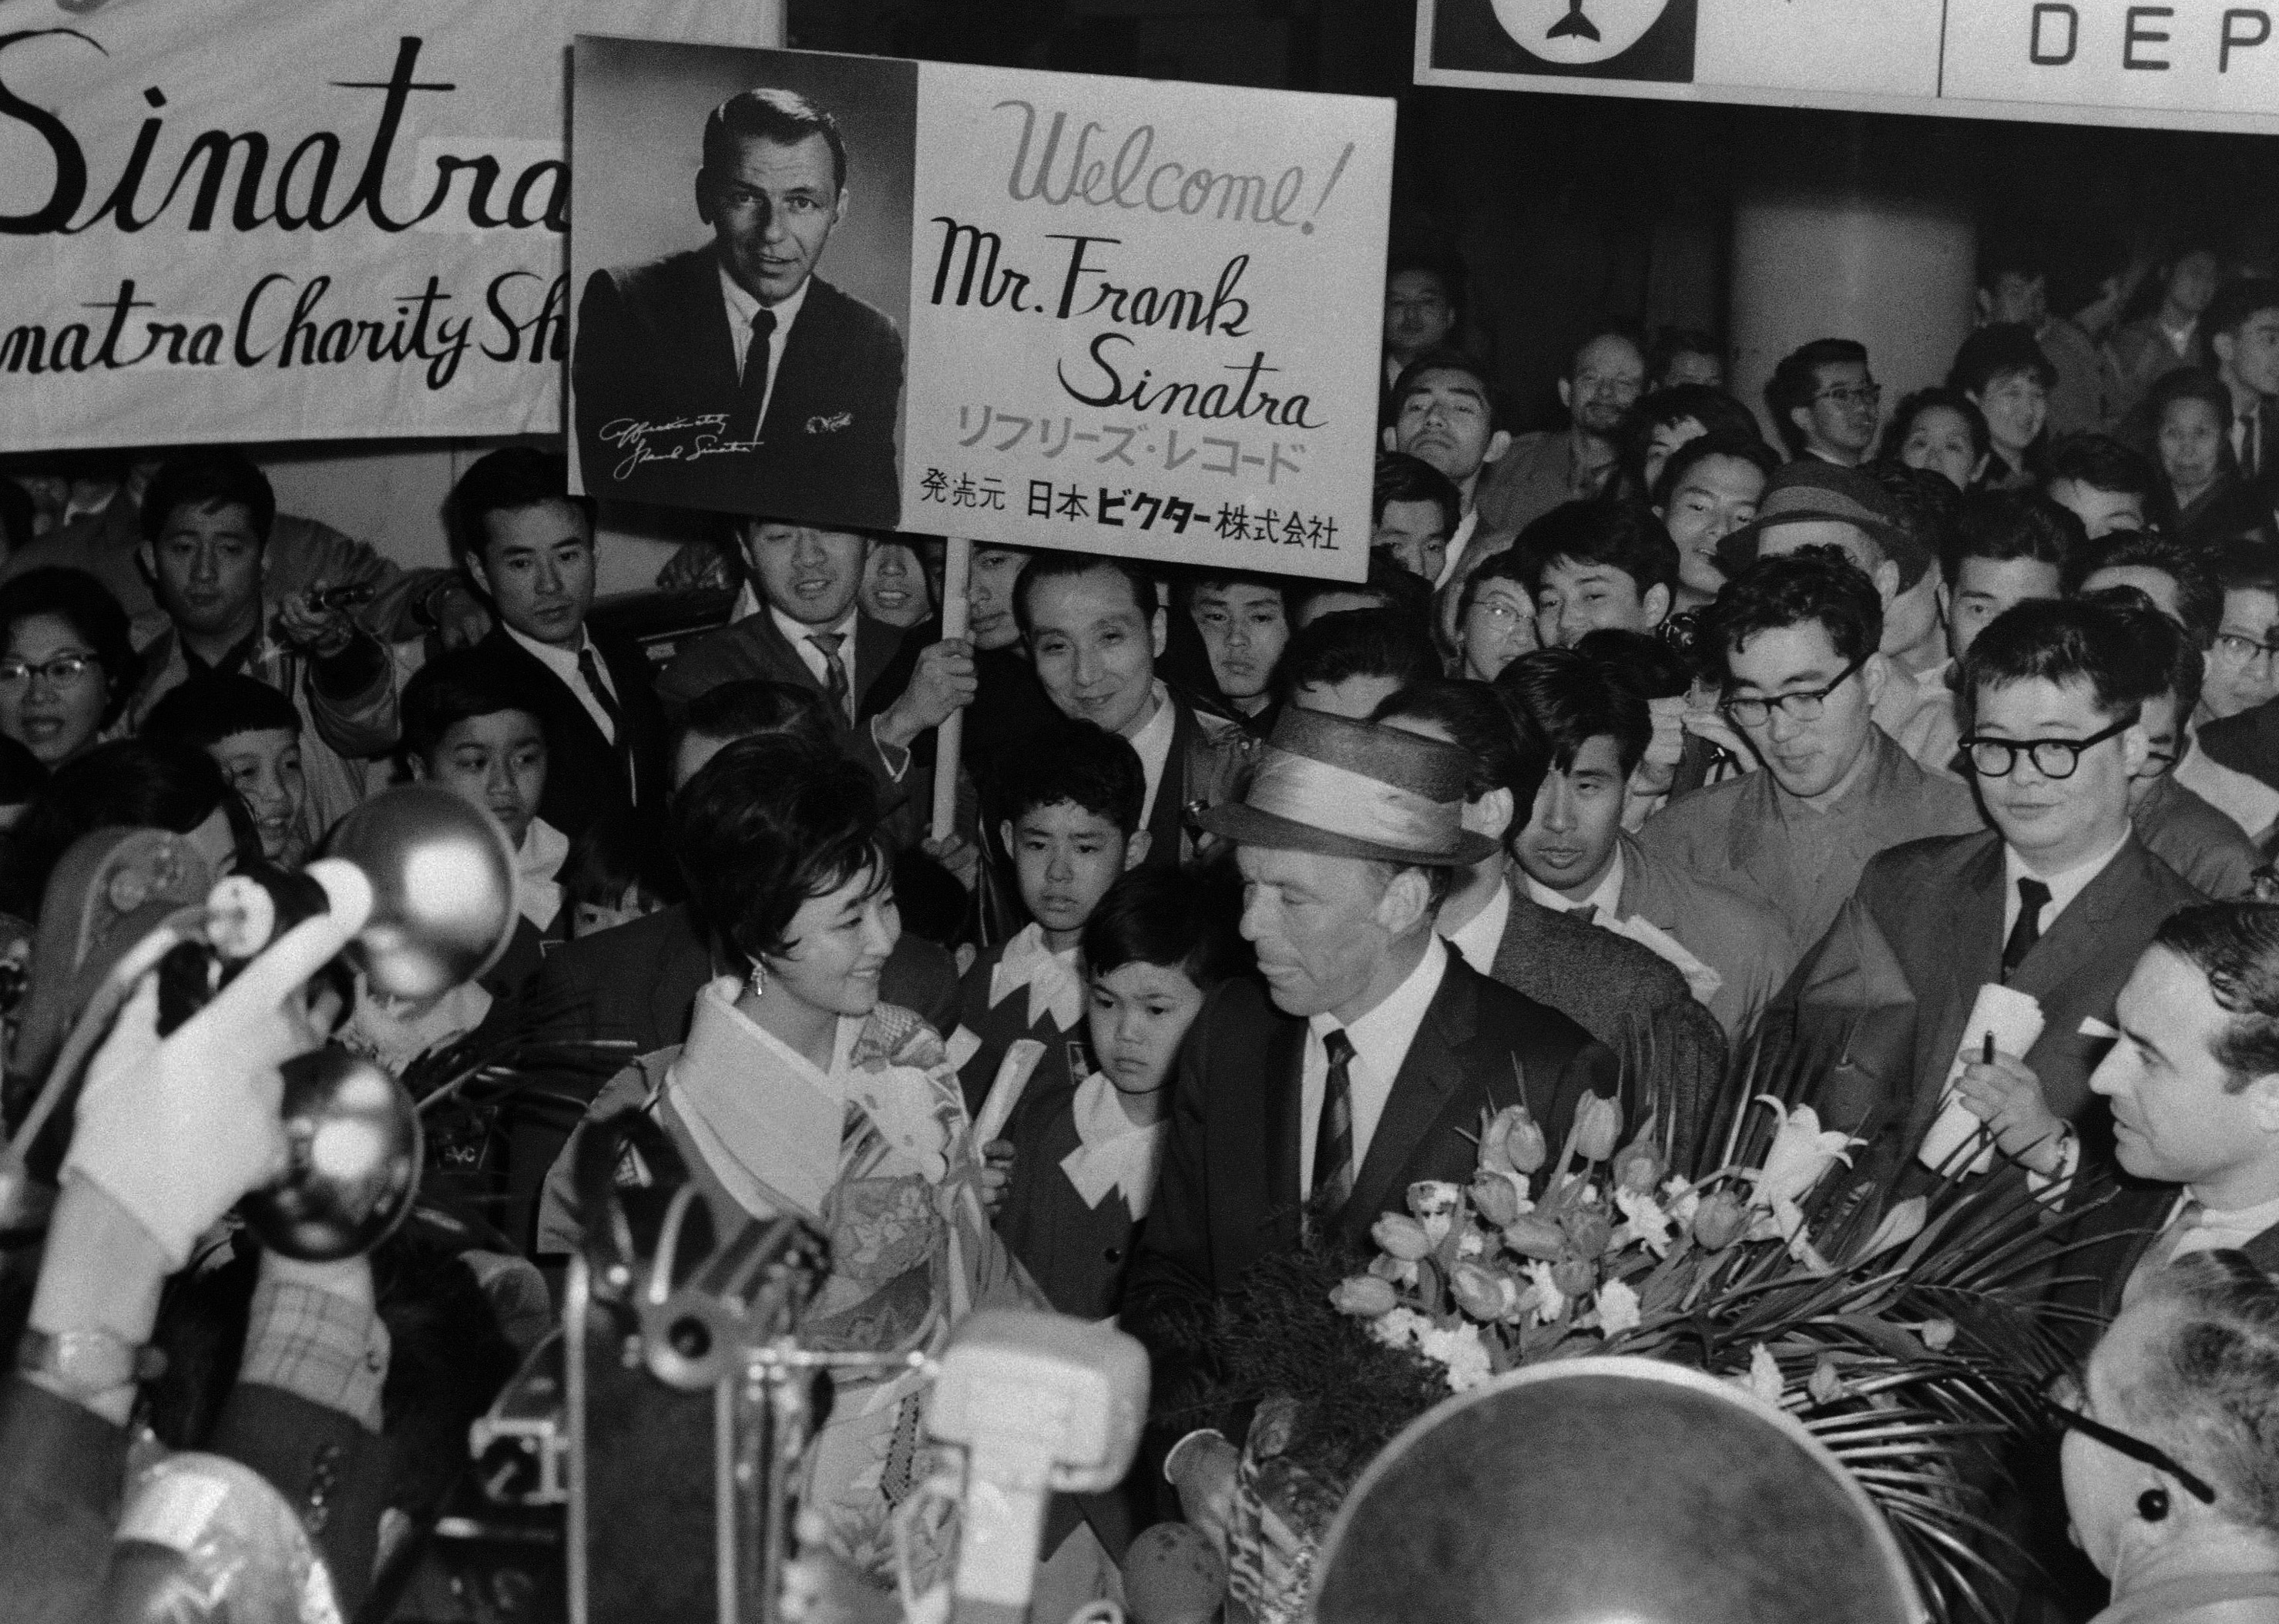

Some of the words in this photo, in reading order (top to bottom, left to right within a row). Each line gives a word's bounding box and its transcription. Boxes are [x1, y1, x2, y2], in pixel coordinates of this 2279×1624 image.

[2030, 2, 2272, 74] DEP
[0, 28, 571, 233] Sinatra
[992, 99, 1356, 236] Welcome!
[233, 273, 475, 391] Charity
[930, 216, 1044, 313] Mr.
[1044, 233, 1252, 337] Frank
[1057, 333, 1329, 429] Sinatra
[921, 468, 1005, 510] 発売元
[1027, 478, 1341, 552] 日本ビクター株式会社
